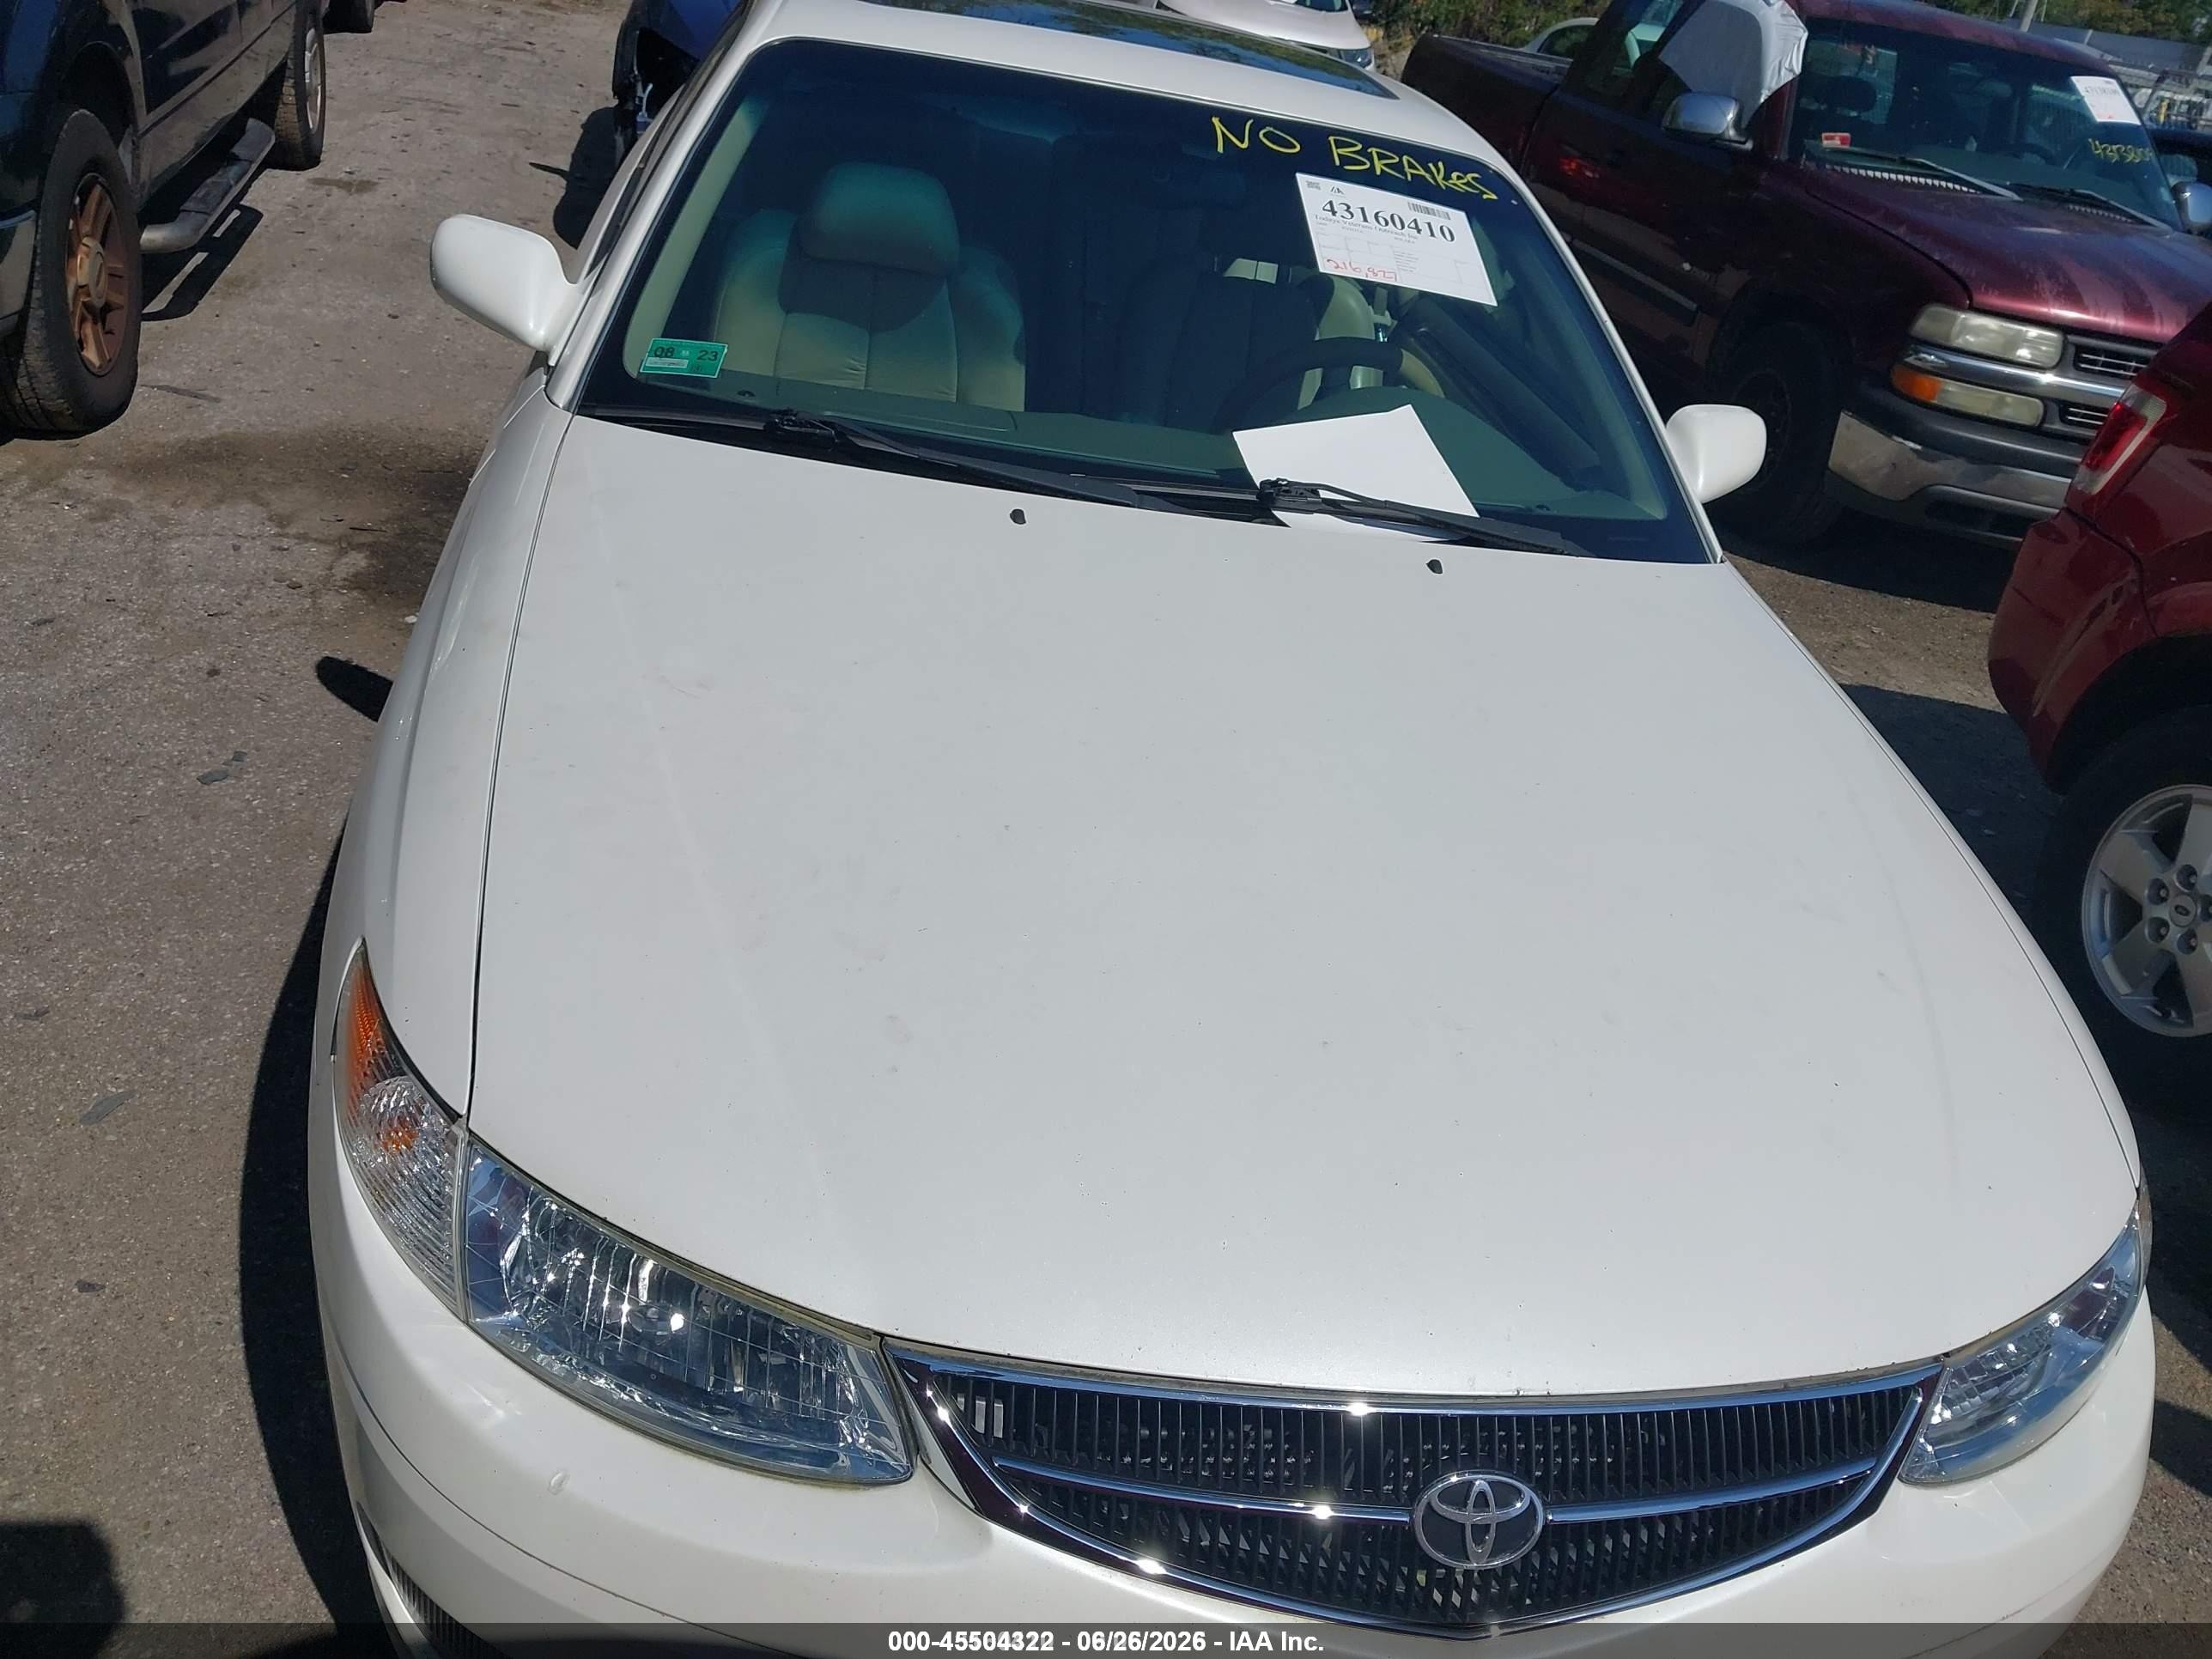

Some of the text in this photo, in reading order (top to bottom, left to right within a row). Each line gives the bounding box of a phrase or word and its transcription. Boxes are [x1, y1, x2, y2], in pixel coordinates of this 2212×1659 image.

[1212, 116, 1301, 154] NO
[1322, 199, 1455, 242] 43160410
[653, 346, 675, 358] 08
[696, 349, 719, 362] 23
